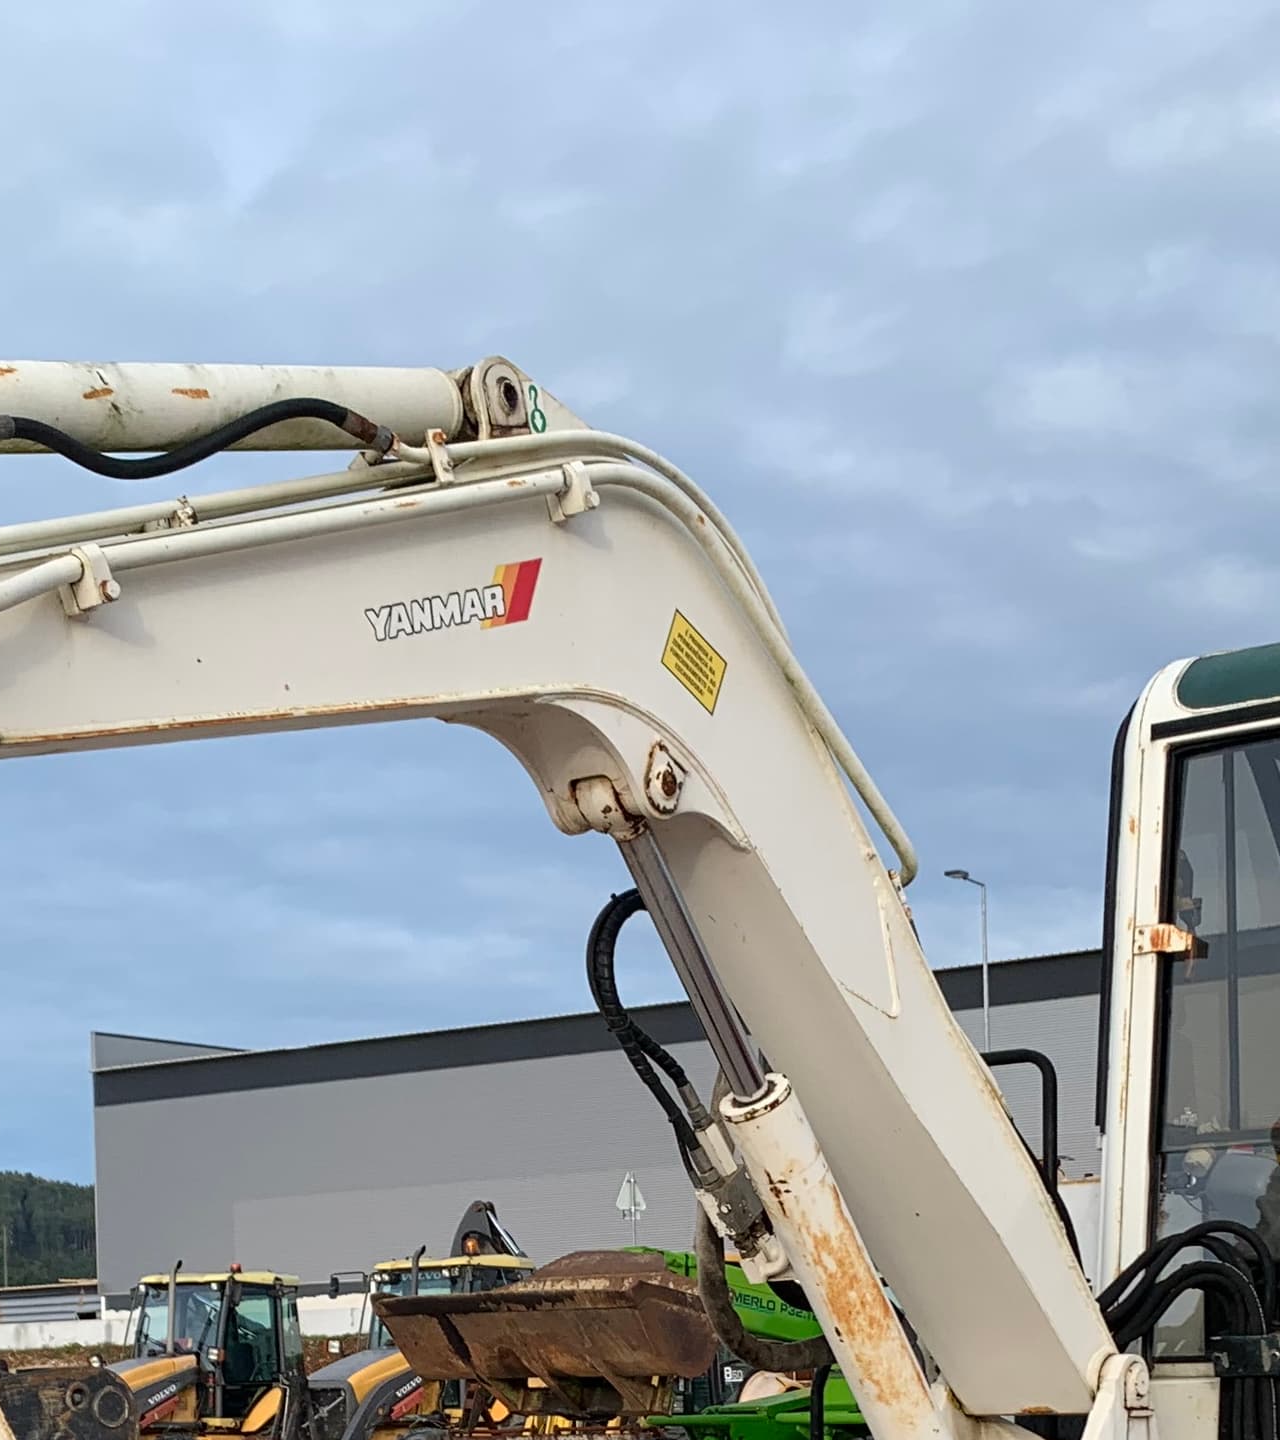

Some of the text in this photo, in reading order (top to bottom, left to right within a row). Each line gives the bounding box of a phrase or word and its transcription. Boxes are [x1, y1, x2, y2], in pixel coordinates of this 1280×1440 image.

[364, 584, 506, 641] YANMAR
[733, 1292, 776, 1312] MERLO
[147, 1383, 178, 1406] VOLVO
[394, 1374, 423, 1398] VOLVO
